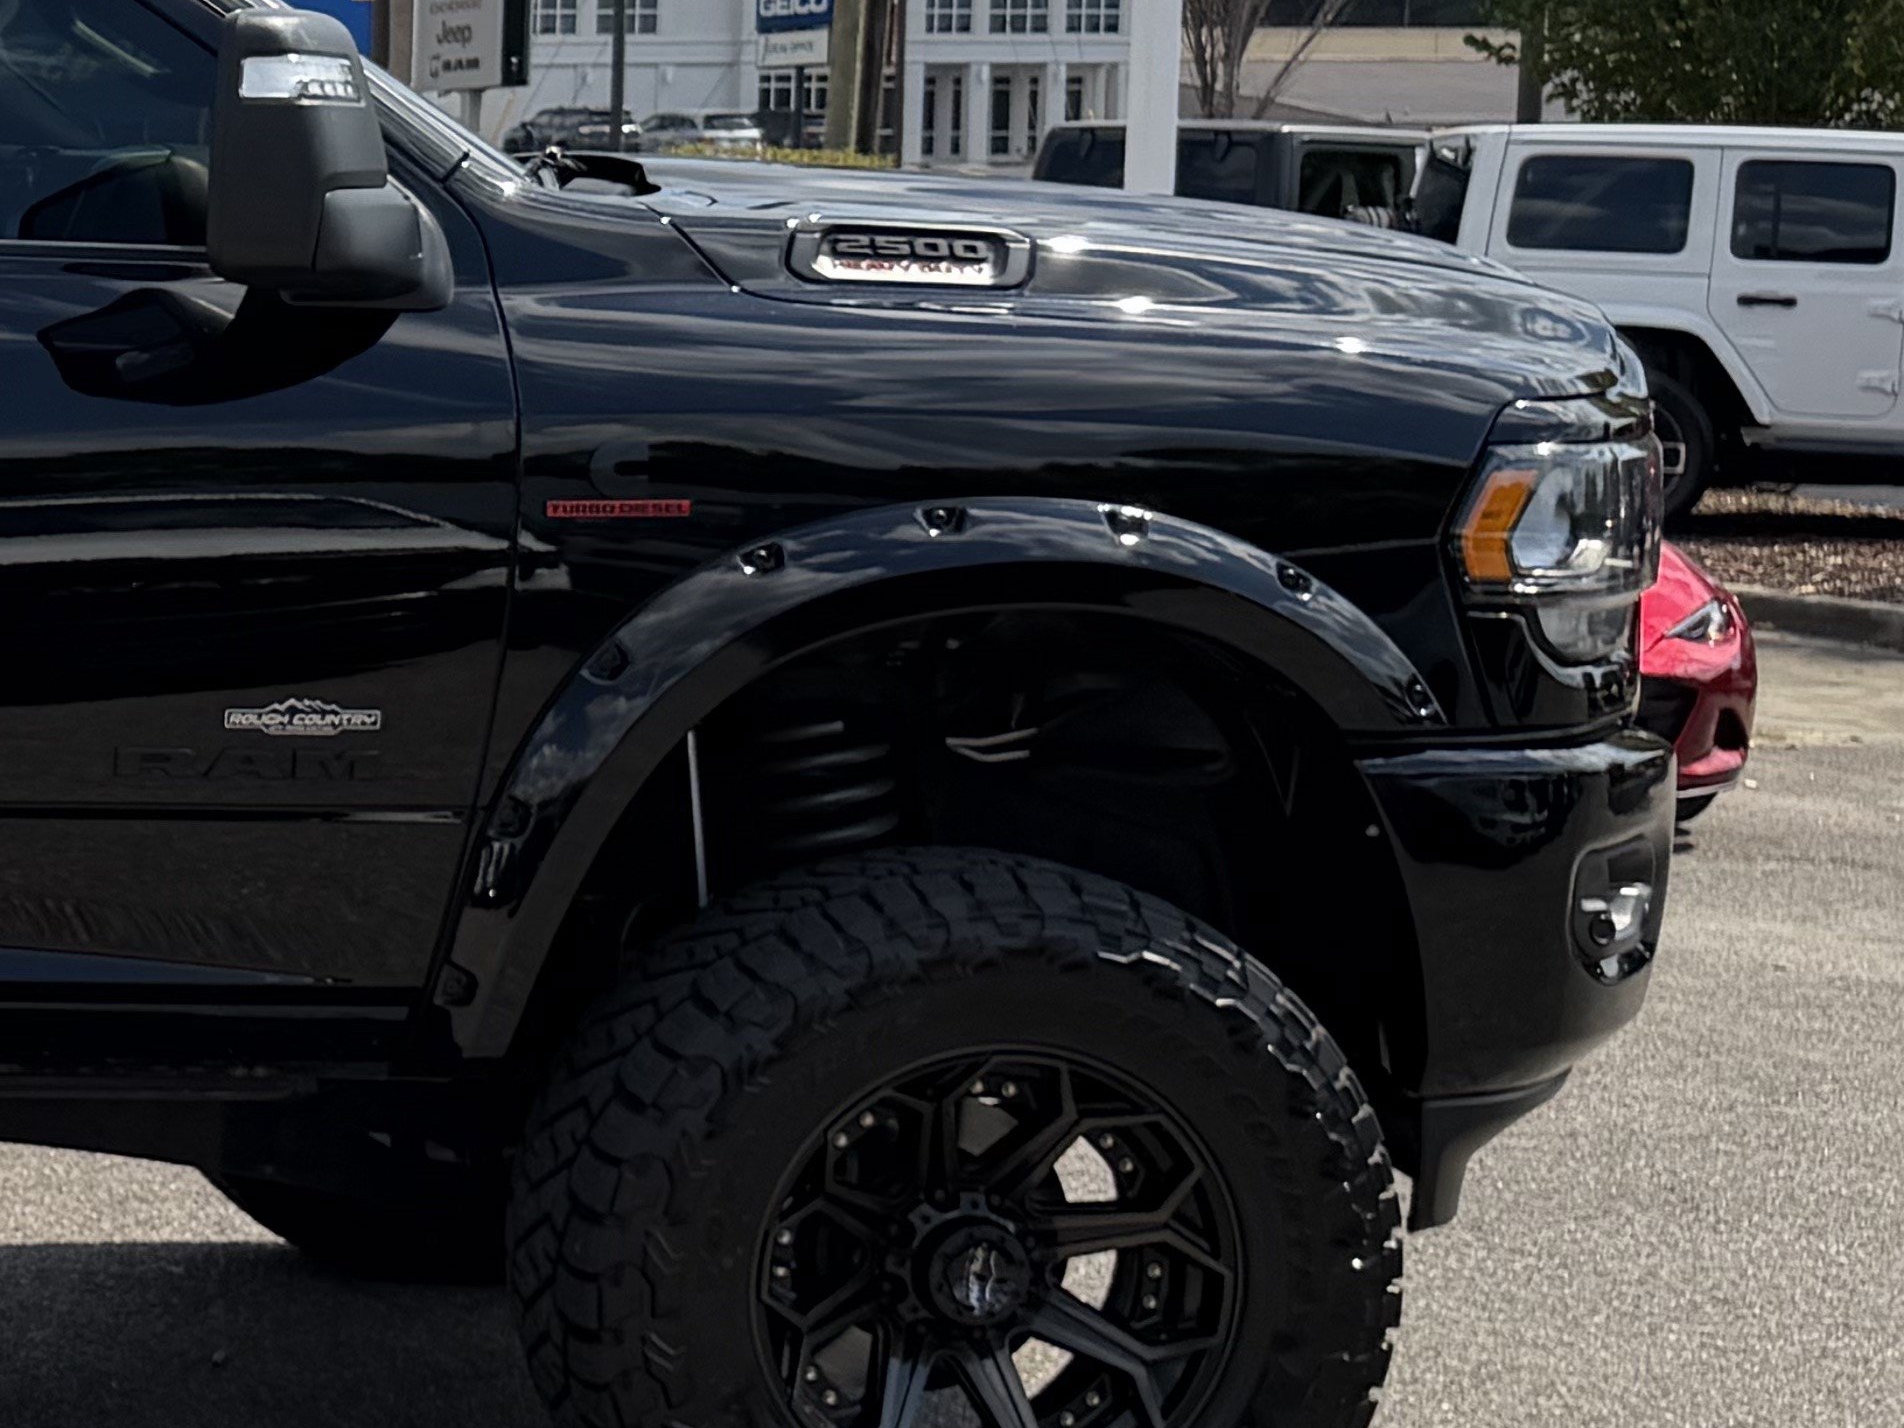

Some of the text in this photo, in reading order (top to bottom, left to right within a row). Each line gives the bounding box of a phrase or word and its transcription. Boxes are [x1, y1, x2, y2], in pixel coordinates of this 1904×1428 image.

[437, 21, 473, 46] Jeep
[835, 234, 989, 260] 2500
[230, 713, 376, 727] ROUGH COUNTRY
[114, 746, 383, 780] RAM
